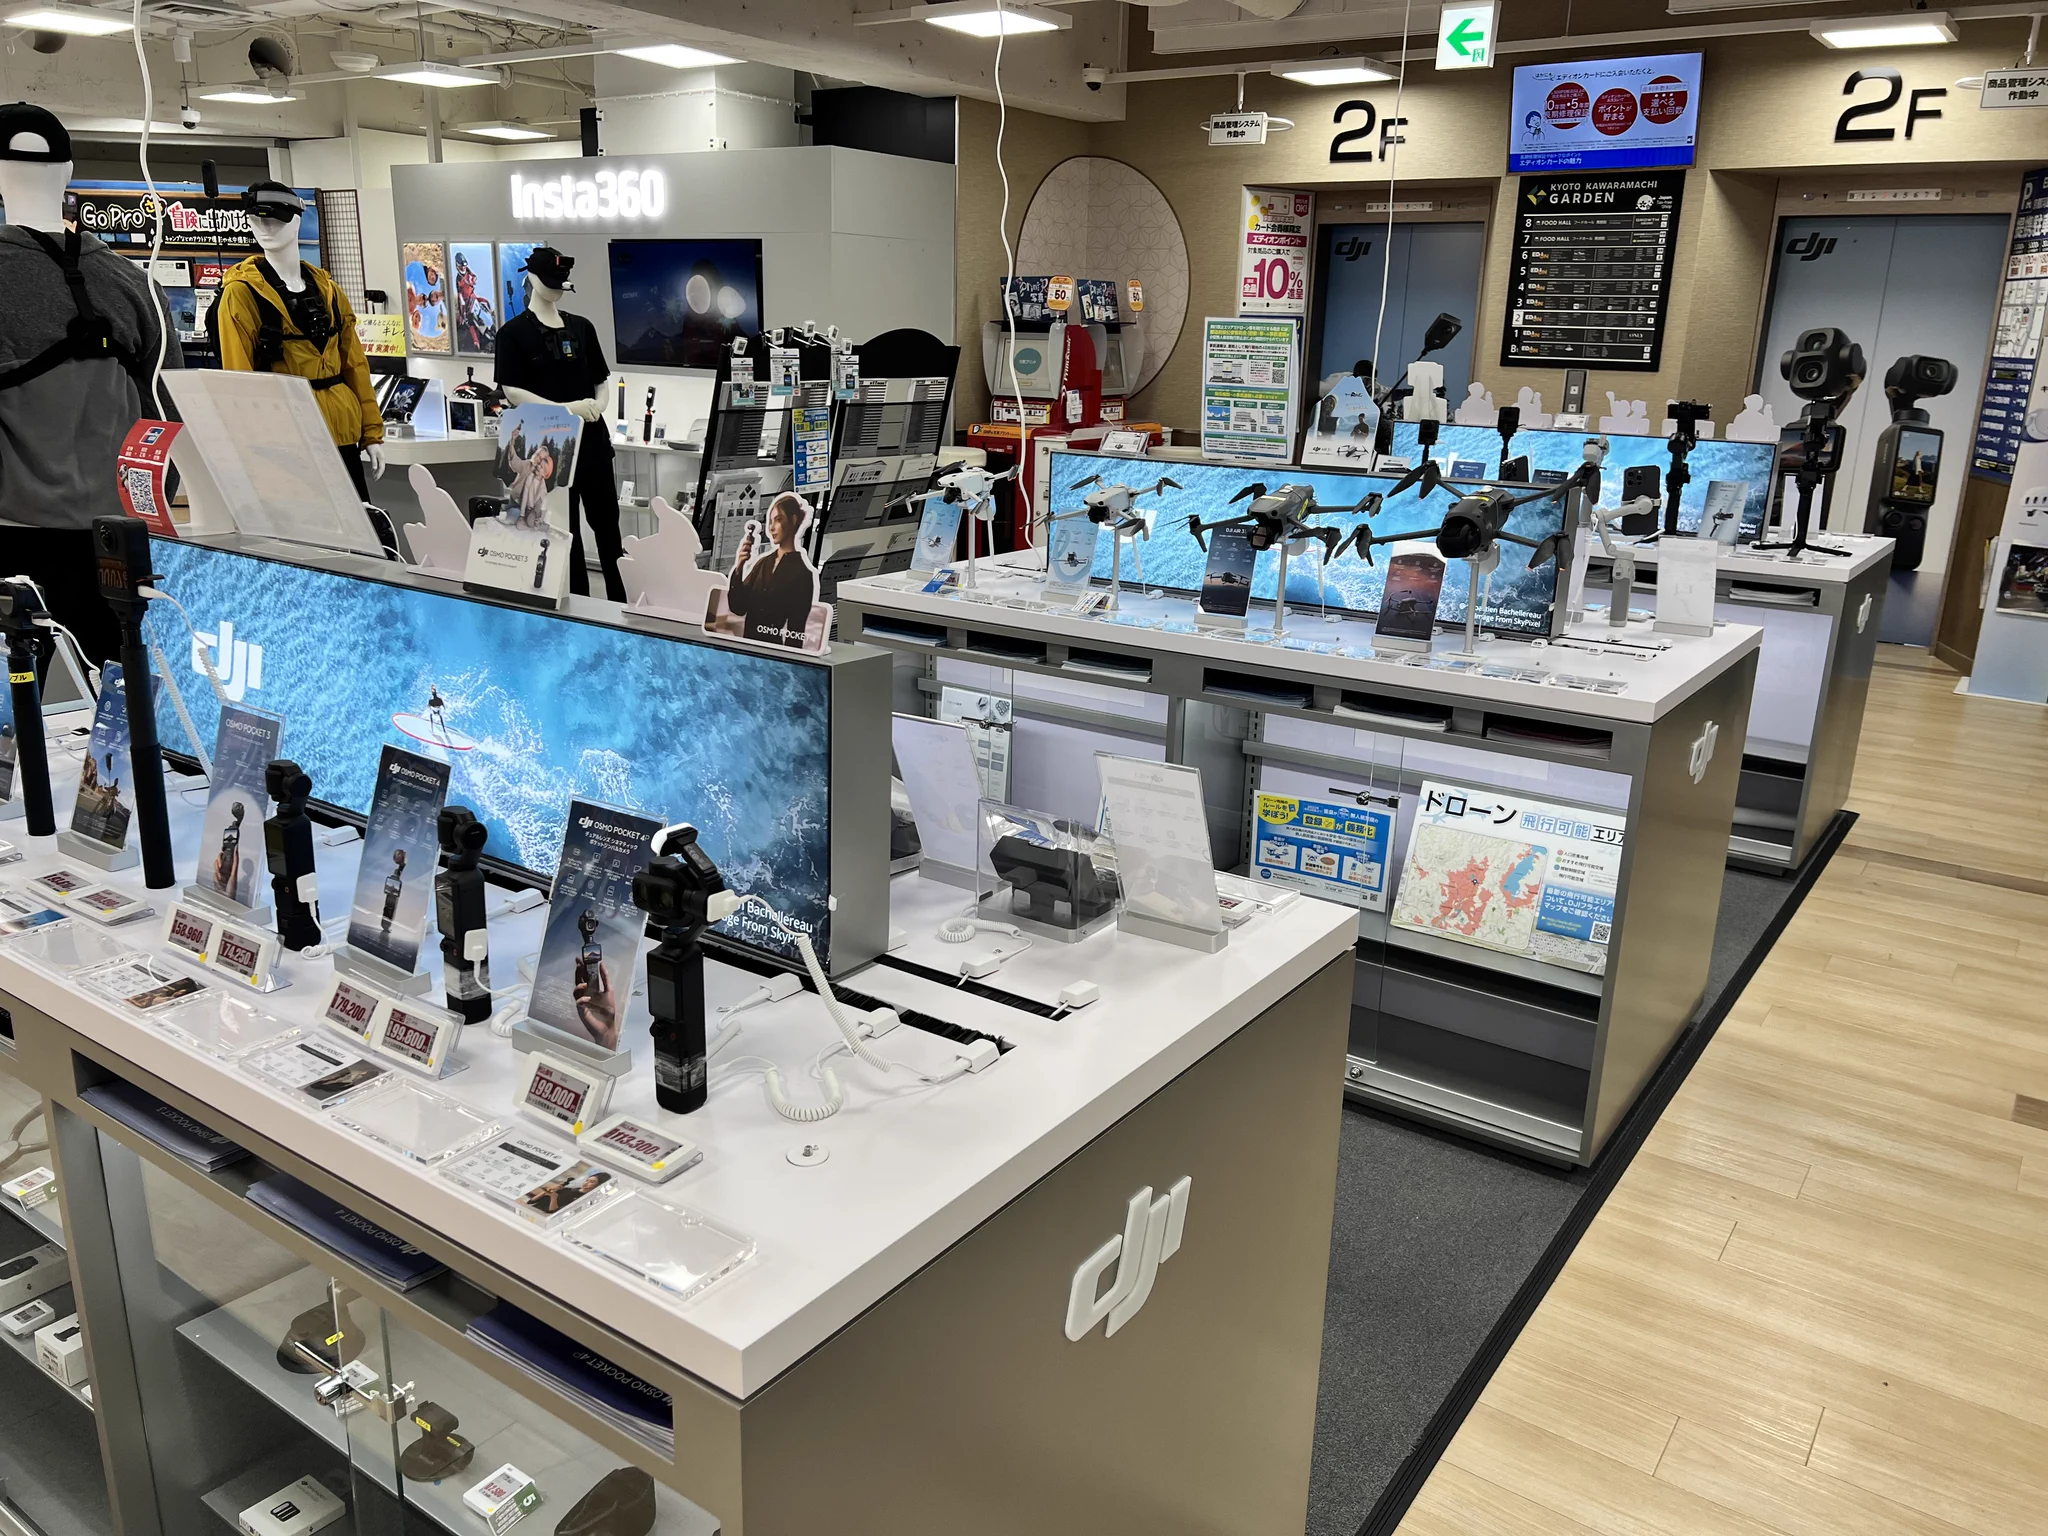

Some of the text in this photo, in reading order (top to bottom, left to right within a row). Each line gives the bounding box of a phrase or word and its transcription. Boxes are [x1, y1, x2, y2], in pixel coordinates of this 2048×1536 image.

[2008, 90, 2039, 100] 作動中
[1835, 67, 1947, 142] 2F
[1330, 100, 1408, 163] 2F
[1550, 181, 1658, 191] KYOTO KAWARAMACHI
[510, 169, 665, 219] Insta360
[1549, 192, 1615, 204] GARDEN
[1525, 218, 1532, 227] 8
[1523, 235, 1530, 244] 7
[1521, 251, 1528, 260] 6
[1520, 267, 1526, 275] 5
[1518, 283, 1524, 291] 4
[1054, 289, 1066, 300] 50
[1516, 298, 1523, 307] 3
[1515, 313, 1520, 322] 2
[489, 550, 505, 558] OSMO
[505, 552, 523, 562] POCKET
[1499, 607, 1542, 619] Bachellereau
[1474, 613, 1540, 627] Image From SkyPixel
[757, 624, 810, 641] OSMO POCKET
[225, 718, 243, 732] OSMO
[243, 723, 267, 738] POCKET
[266, 731, 271, 740] 3
[400, 767, 415, 778] OSMO
[415, 772, 436, 785] POCKET
[1262, 803, 1288, 811] ルールを
[1262, 809, 1289, 820] 学ぼう!
[1425, 789, 1518, 825] ドローン
[1521, 812, 1590, 840] 飛行可能
[594, 821, 613, 833] OSMO
[613, 826, 641, 840] POCKET
[742, 916, 769, 936] From
[516, 1140, 534, 1150] OSMO
[533, 1145, 555, 1159] POCKET
[340, 1214, 377, 1235] POCKET
[374, 1231, 402, 1246] OSMO
[586, 1358, 633, 1384] POCKET
[630, 1380, 663, 1398] OSMO
